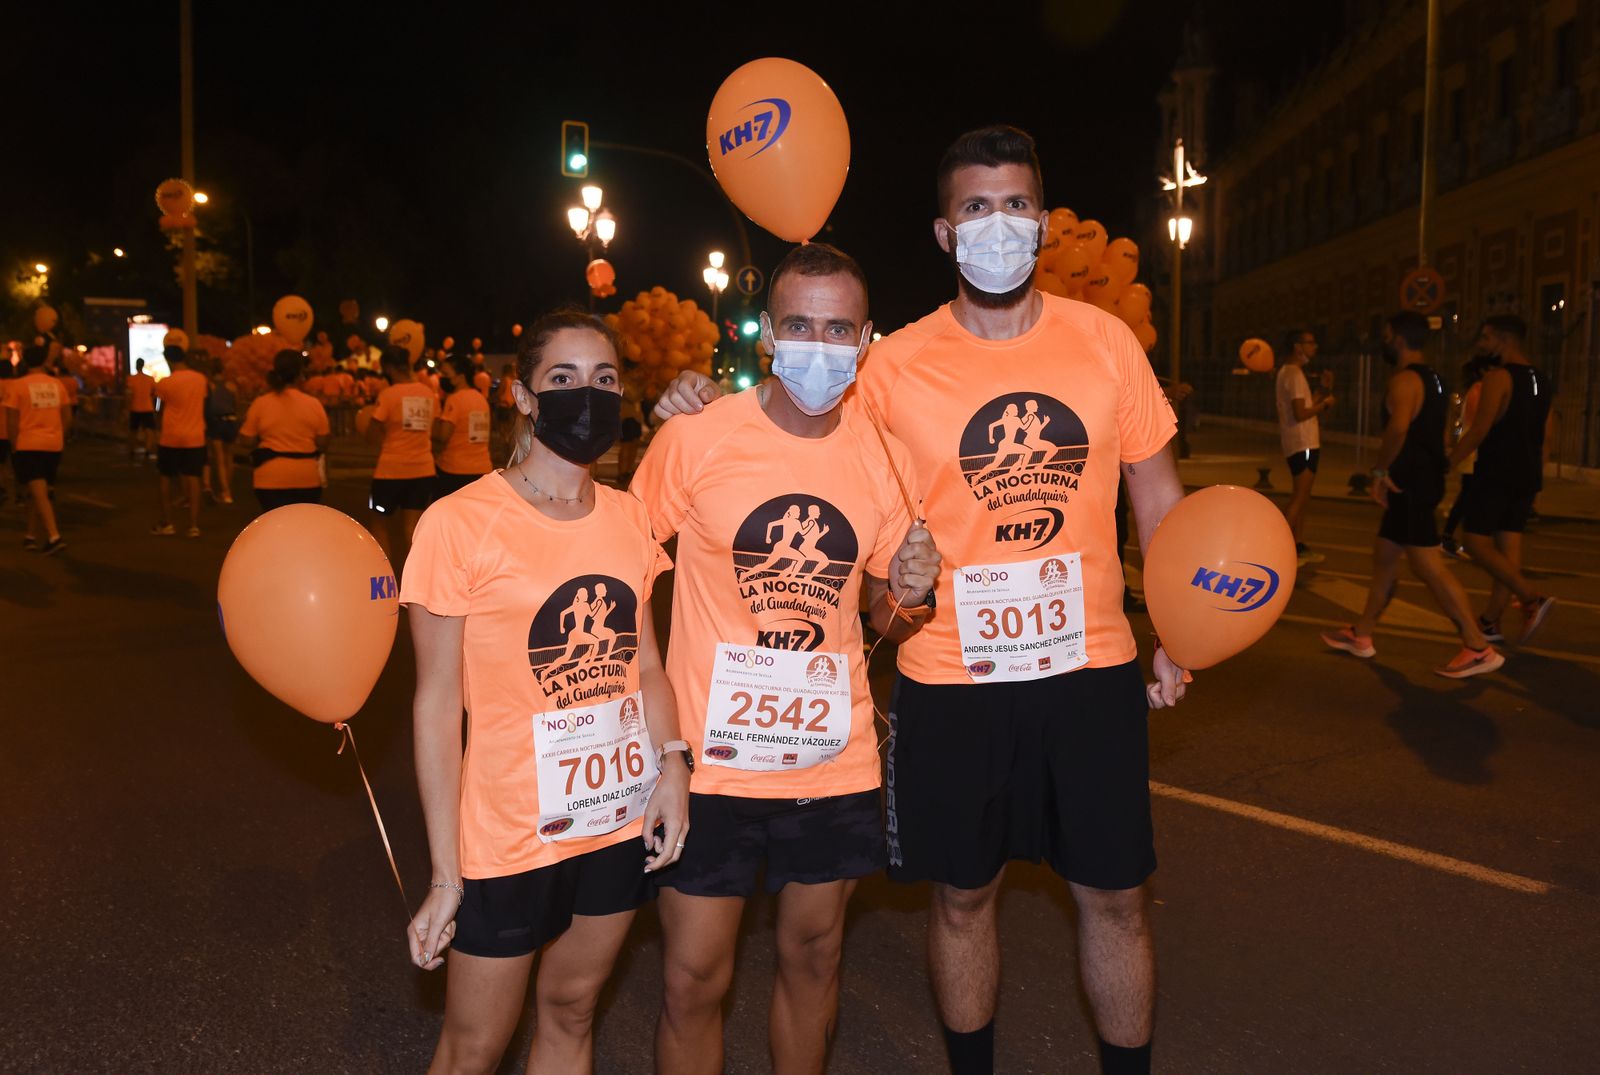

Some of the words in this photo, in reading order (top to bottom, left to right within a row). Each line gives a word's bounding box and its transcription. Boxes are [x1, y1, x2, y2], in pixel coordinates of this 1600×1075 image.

[973, 485, 994, 501] LA
[995, 472, 1079, 492] NOCTURNA
[987, 496, 1003, 511] del
[1003, 488, 1070, 505] Guadalquivir
[739, 584, 759, 599] LA
[762, 580, 840, 609] NOCTURNA
[750, 599, 766, 614] del
[766, 596, 828, 620] Guadalquivir
[976, 598, 1067, 640] 3013
[964, 645, 994, 654] ANDRES
[994, 644, 1019, 653] JESUS
[1019, 640, 1053, 651] SANCHEZ
[1052, 630, 1084, 645] CHANIVET
[542, 680, 563, 698] LA
[556, 695, 572, 710] del
[727, 691, 831, 733] 2542
[709, 729, 744, 742] RAFAEL
[746, 732, 800, 746] FERNÁNDEZ
[801, 736, 842, 747] VÁZQUEZ
[558, 741, 645, 796] 7016
[886, 712, 899, 835] UNDER
[567, 798, 602, 812] LORENA
[602, 790, 620, 803] DIAZ
[621, 782, 643, 798] LOPEZ
